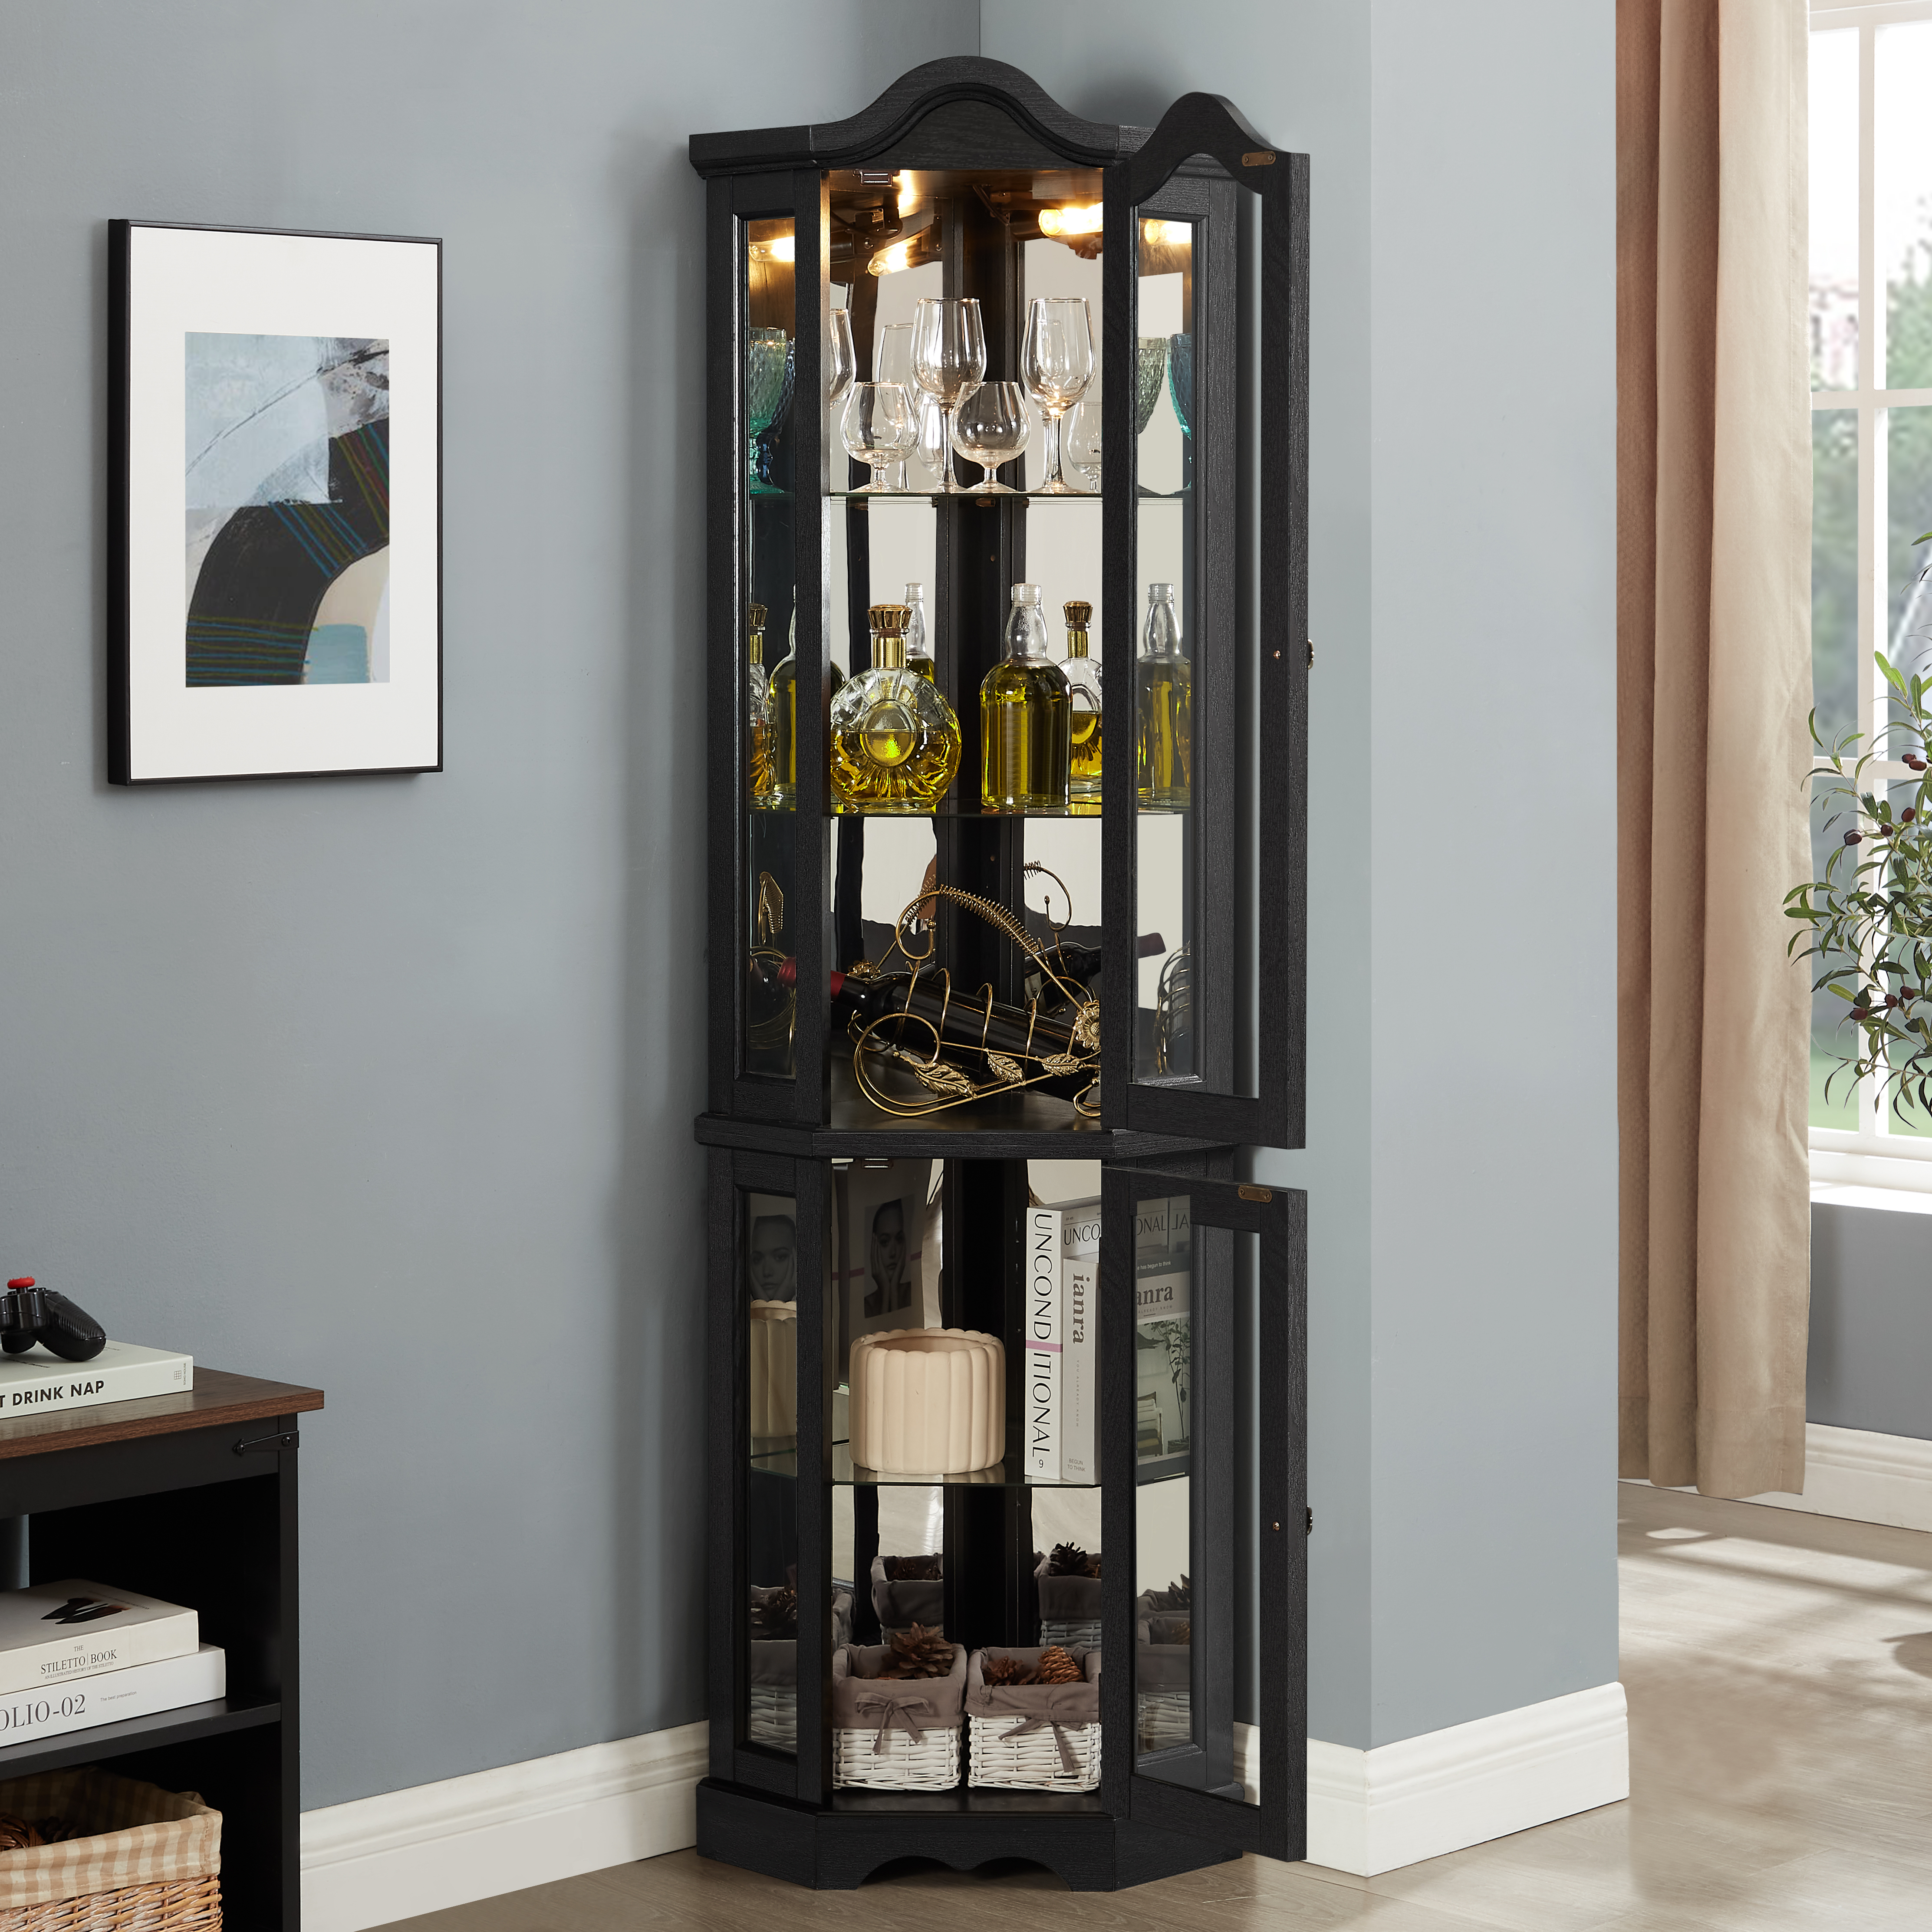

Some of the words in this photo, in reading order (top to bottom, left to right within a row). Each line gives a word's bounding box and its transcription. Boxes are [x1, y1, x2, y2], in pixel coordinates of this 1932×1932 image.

[1073, 1273, 1090, 1344] ianra
[13, 1386, 63, 1406] DRINK
[71, 1380, 104, 1397] NAP
[1039, 1459, 1043, 1468] 9
[41, 1656, 86, 1674] STILETTO
[91, 1649, 117, 1664] BOOK
